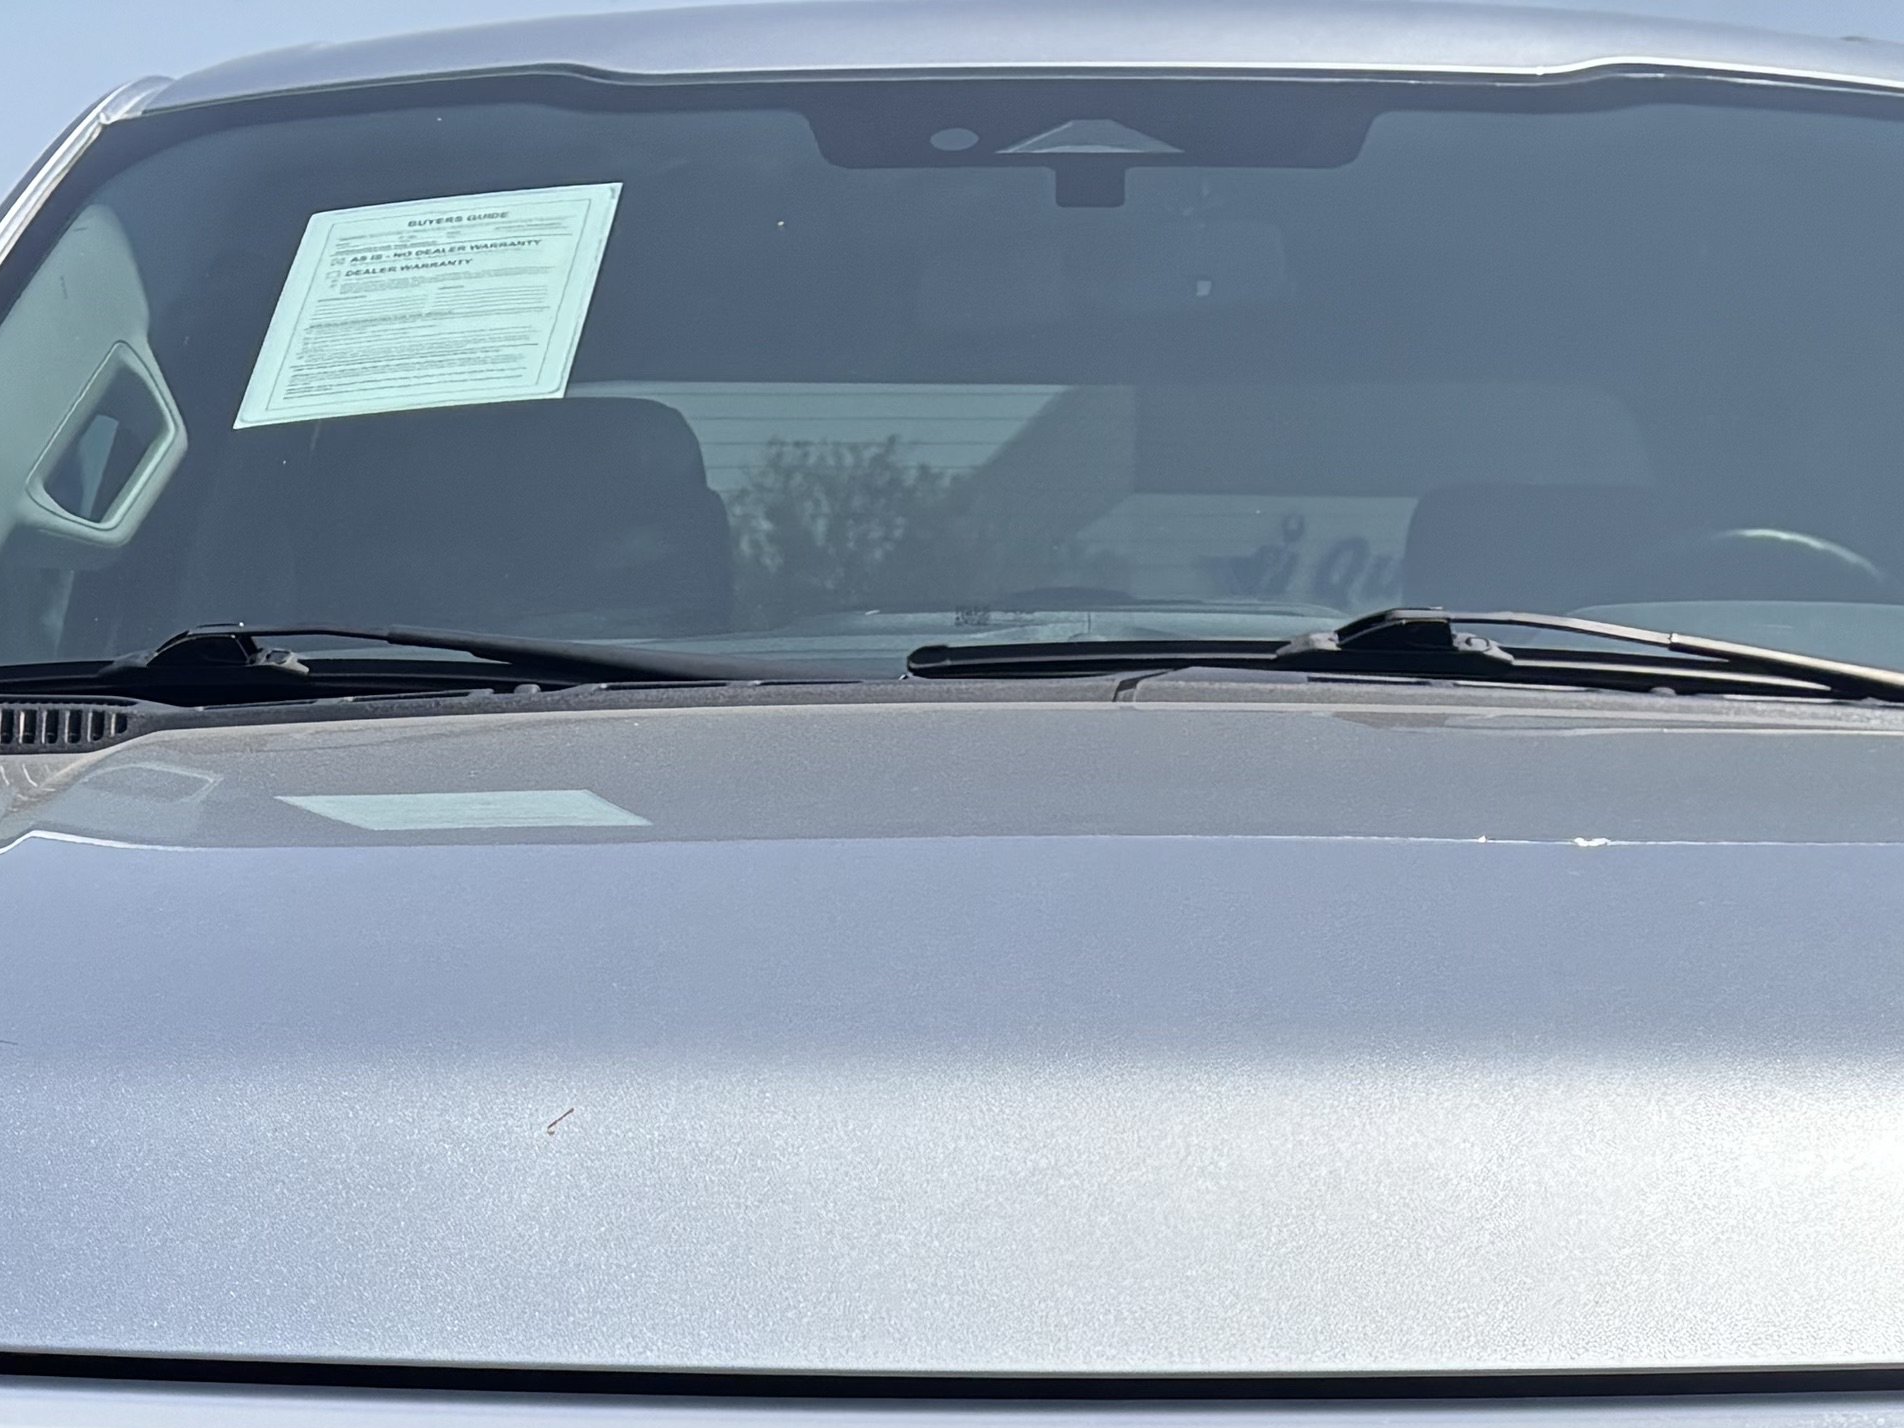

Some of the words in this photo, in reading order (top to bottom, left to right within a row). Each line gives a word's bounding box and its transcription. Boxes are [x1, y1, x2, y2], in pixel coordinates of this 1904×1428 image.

[407, 215, 463, 228] BUYERS
[415, 244, 467, 257] DEALER
[470, 239, 543, 251] WARRANTY
[345, 265, 397, 277] DEALER
[400, 258, 473, 271] WARRANTY
